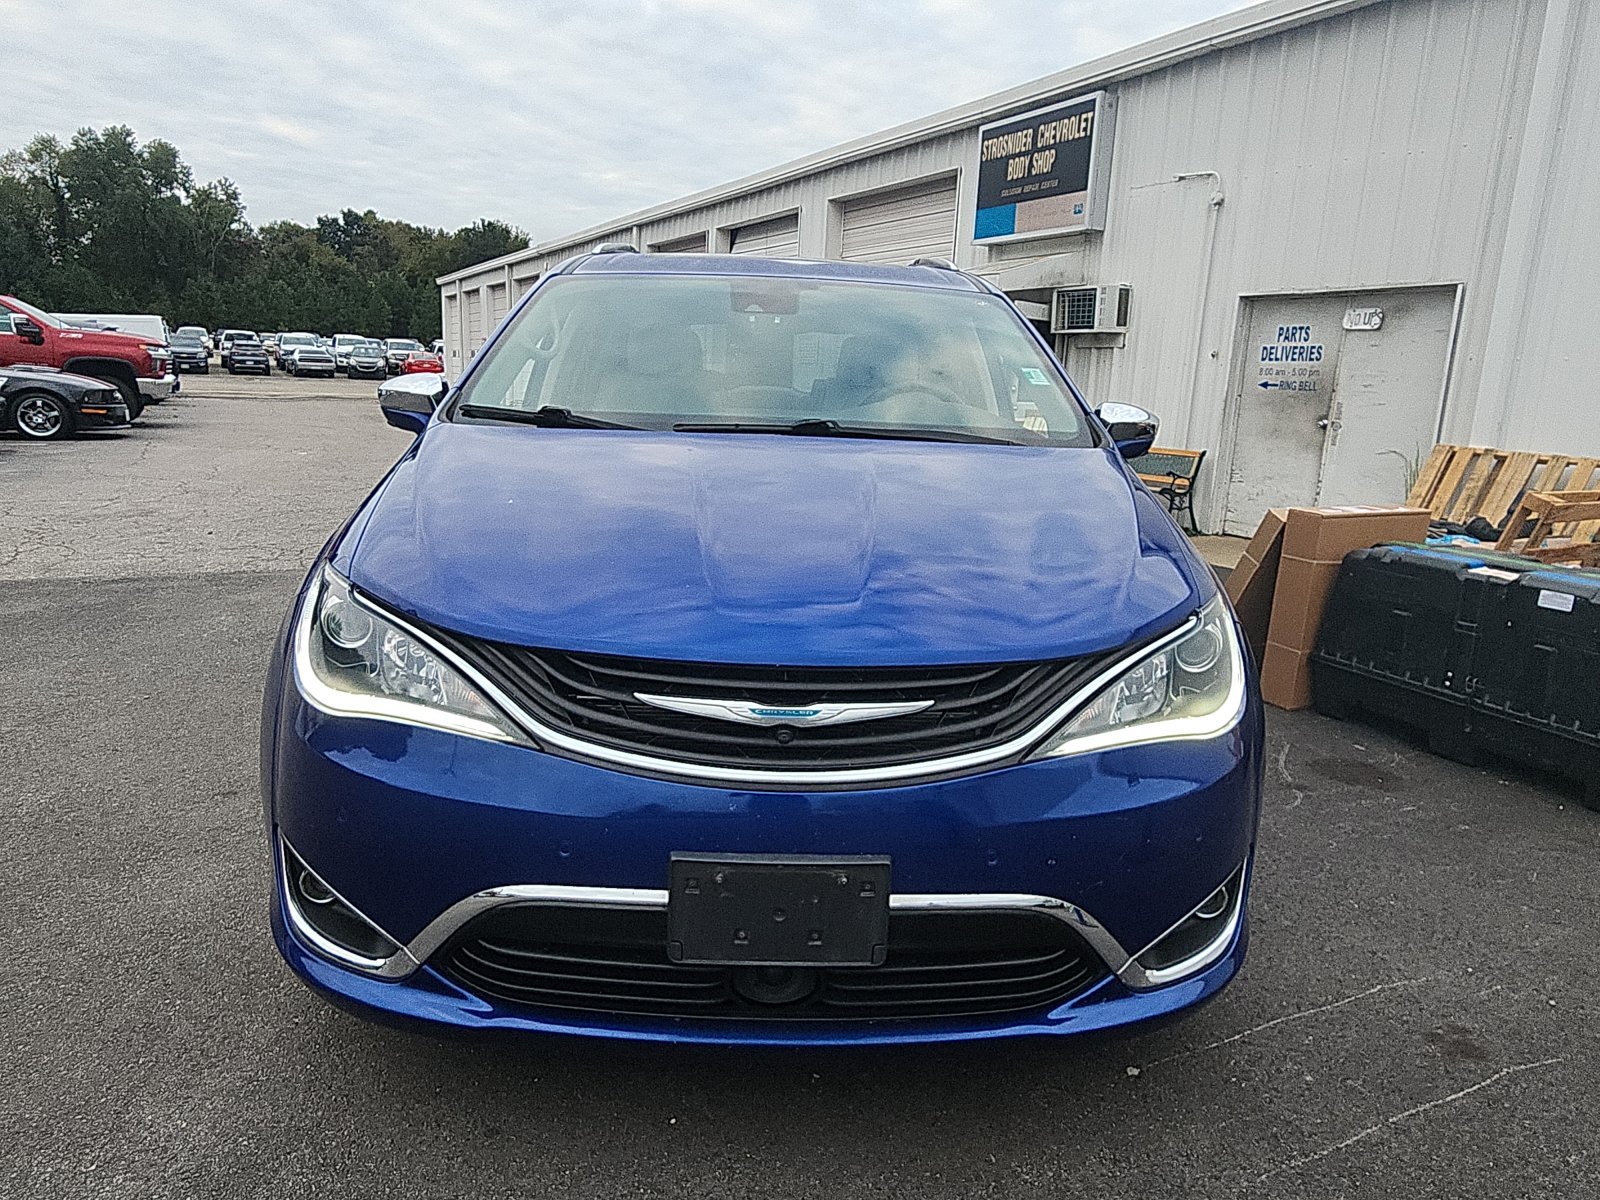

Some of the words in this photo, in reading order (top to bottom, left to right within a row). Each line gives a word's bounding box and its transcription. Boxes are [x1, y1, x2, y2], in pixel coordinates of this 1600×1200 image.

[982, 128, 1034, 162] STROSNIDER
[1037, 111, 1094, 147] CHEVROLET
[1007, 155, 1031, 181] BODY
[1031, 149, 1056, 176] SHOP
[1277, 325, 1311, 343] PARTS
[1260, 345, 1323, 362] DELIVERIES
[1308, 369, 1320, 378] pm
[1279, 380, 1297, 391] RING
[1298, 380, 1317, 392] BELL
